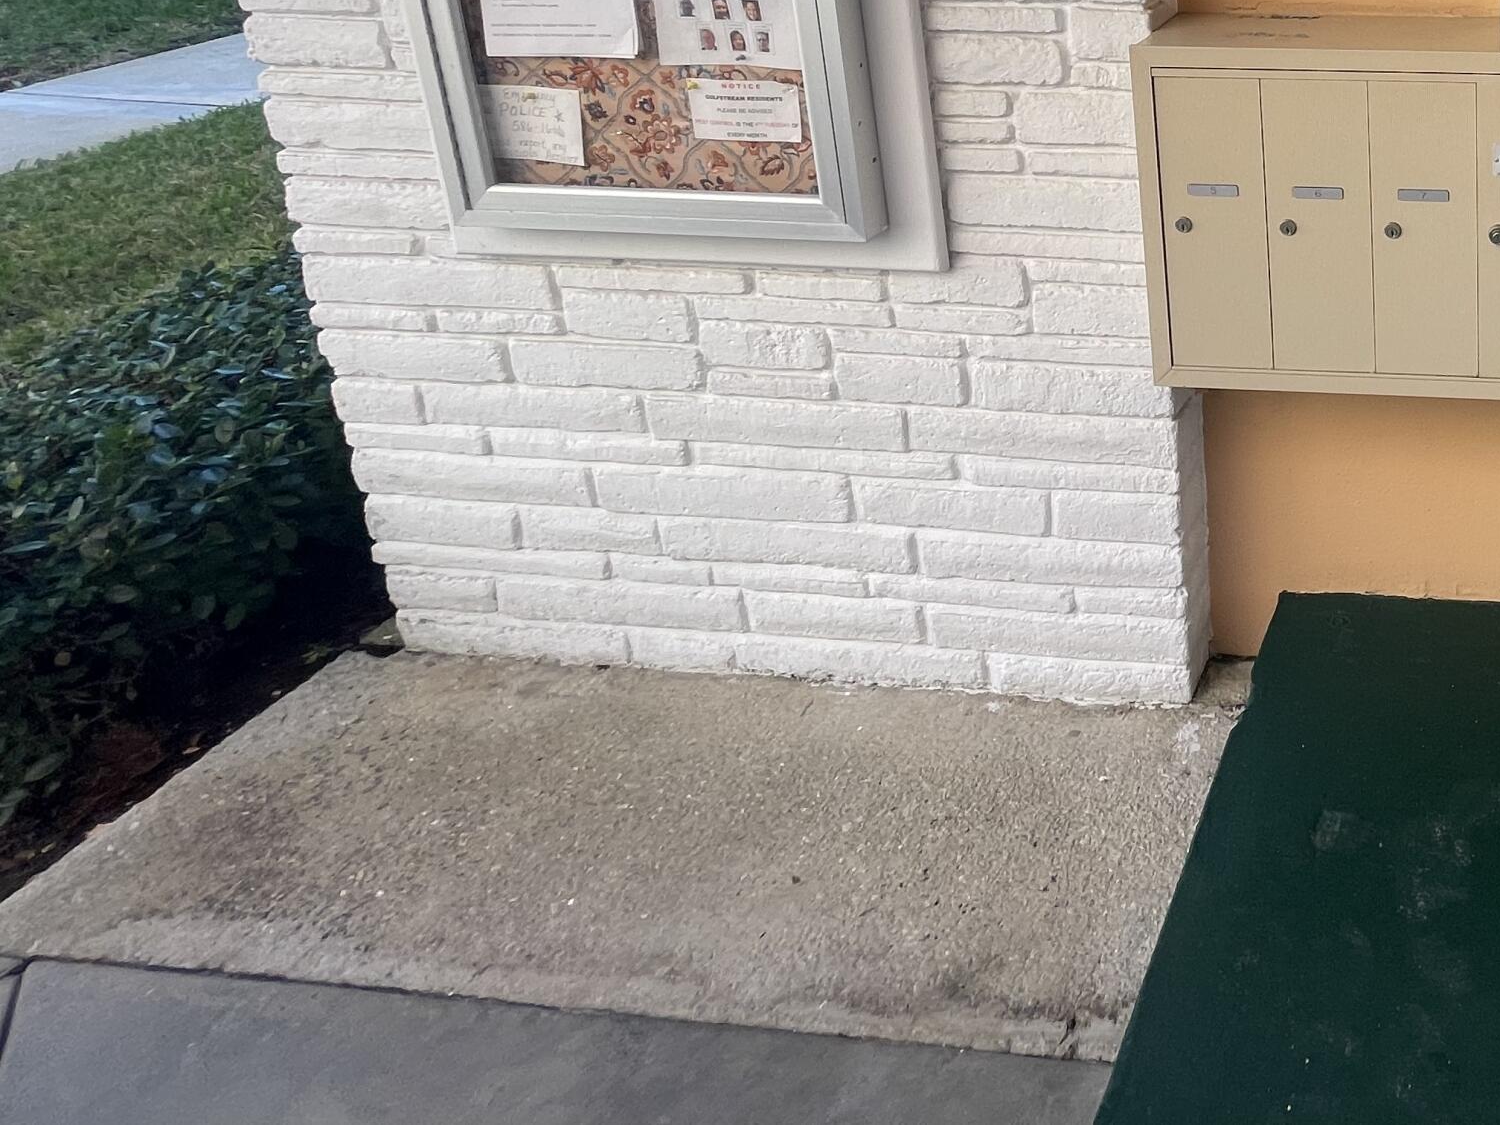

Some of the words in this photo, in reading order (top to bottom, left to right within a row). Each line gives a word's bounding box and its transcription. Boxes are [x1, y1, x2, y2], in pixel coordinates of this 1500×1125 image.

[721, 82, 761, 90] NOTICE
[1209, 186, 1217, 195] 5
[1314, 189, 1322, 198] 6
[1420, 192, 1428, 200] 7
